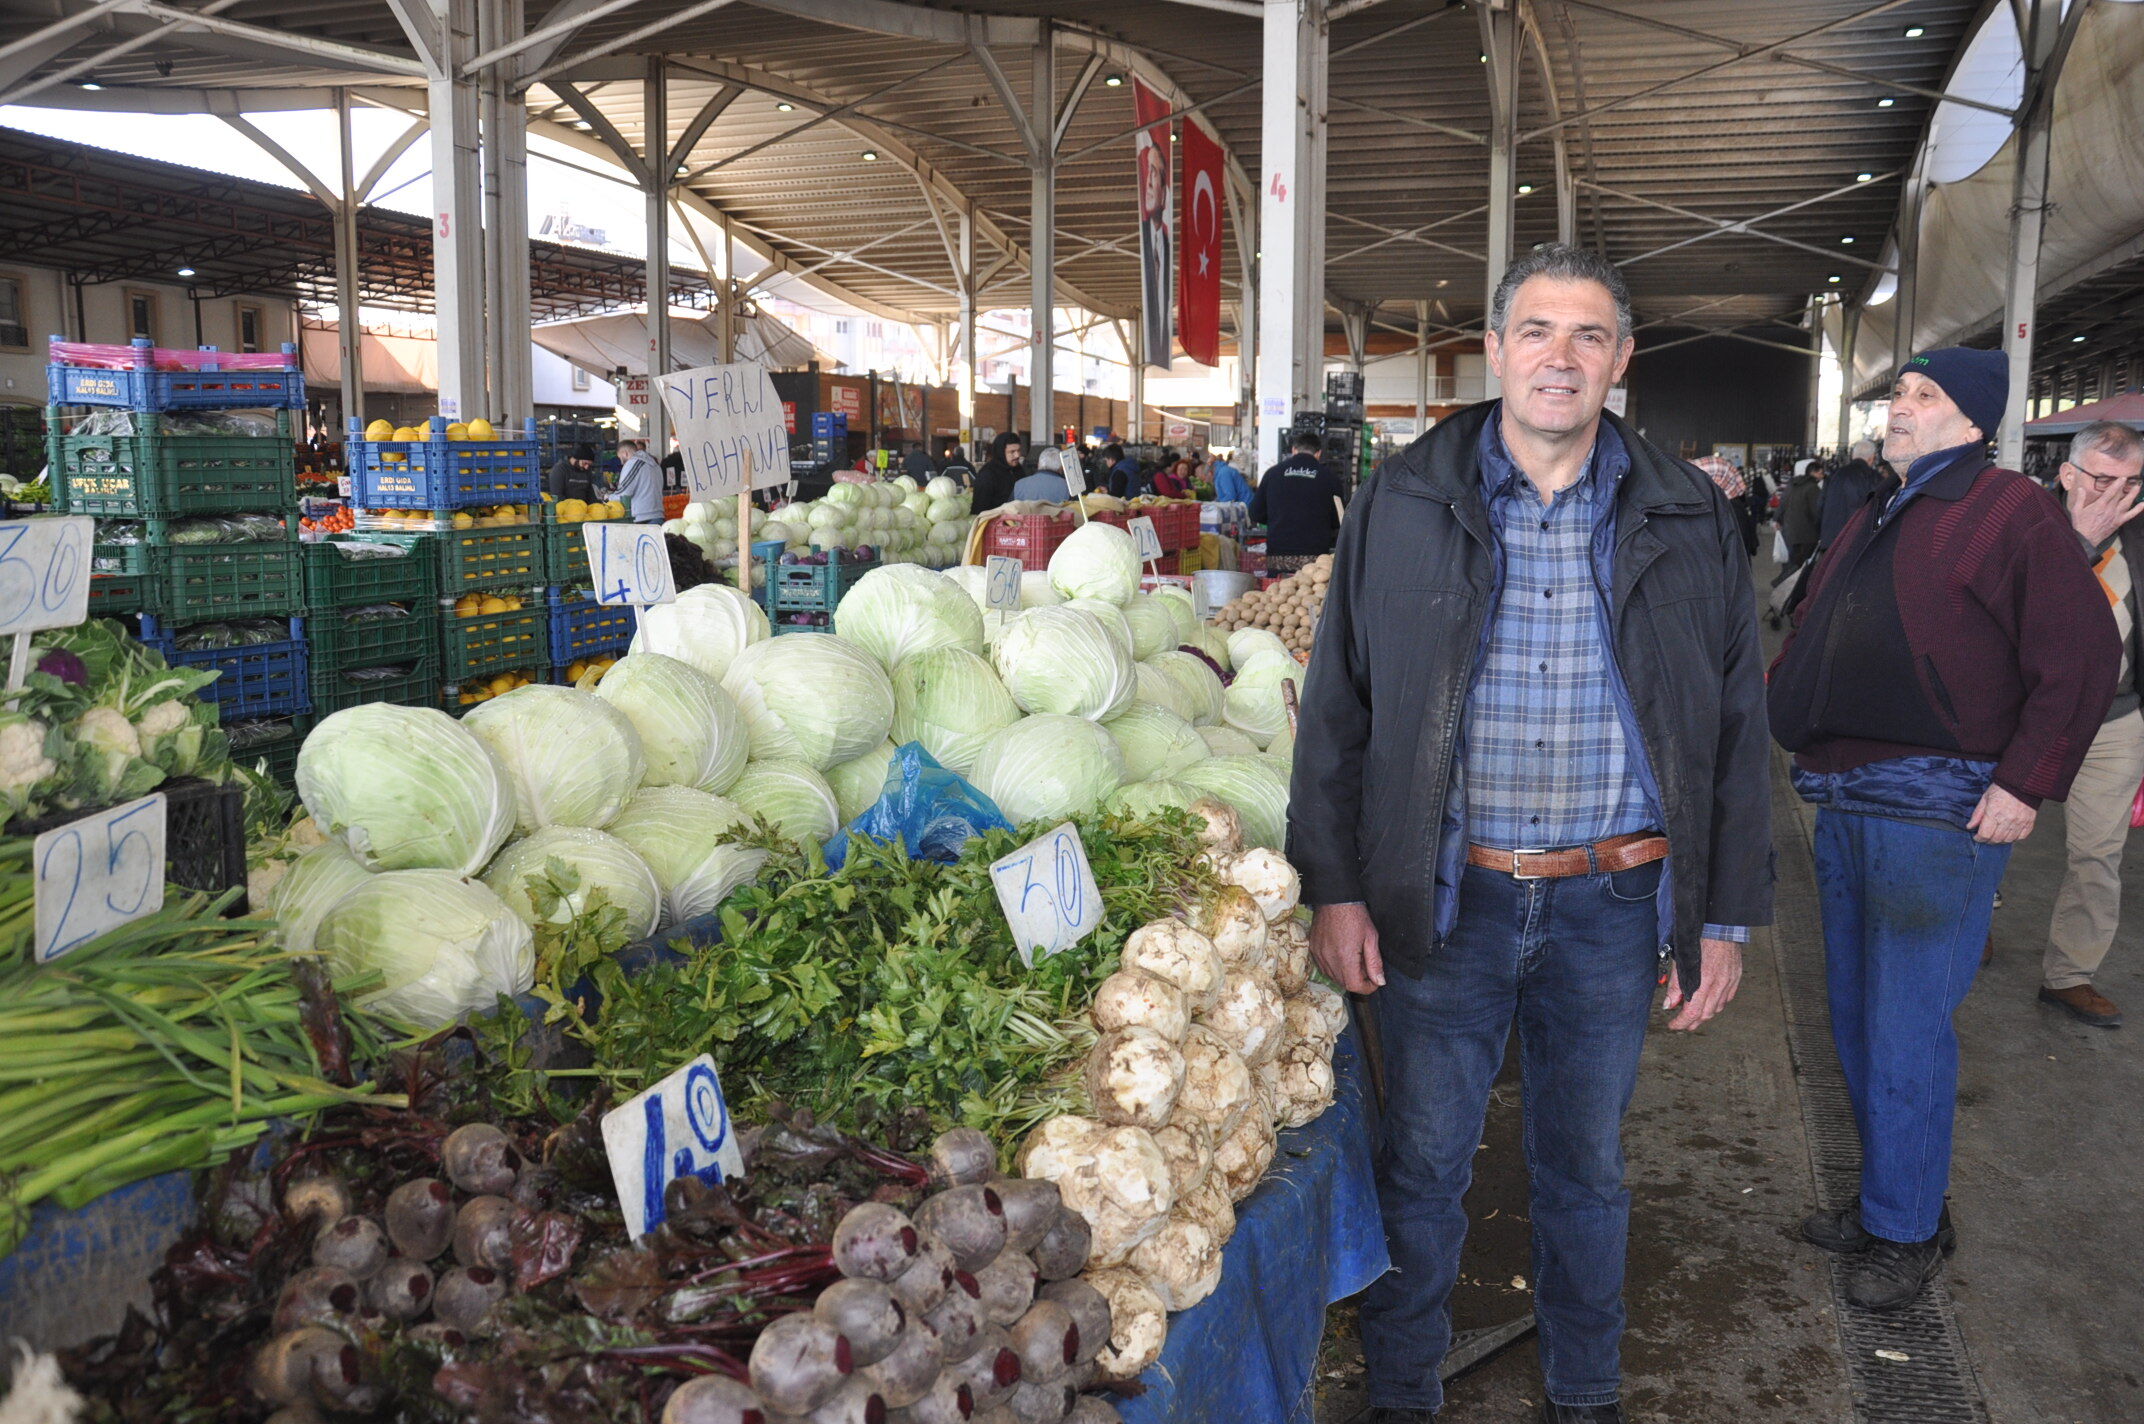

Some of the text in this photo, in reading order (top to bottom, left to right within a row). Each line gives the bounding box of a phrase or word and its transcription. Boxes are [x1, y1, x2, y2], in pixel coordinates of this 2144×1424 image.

[439, 213, 449, 239] 3
[650, 339, 656, 351] 2
[1035, 330, 1042, 344] 3
[2018, 323, 2027, 339] 5
[602, 525, 666, 602] 40
[1133, 525, 1160, 557] 20
[0, 522, 82, 628] 30
[990, 557, 1022, 606] 30
[41, 798, 158, 960] 25
[996, 833, 1082, 958] 30
[643, 1062, 727, 1234] 40
